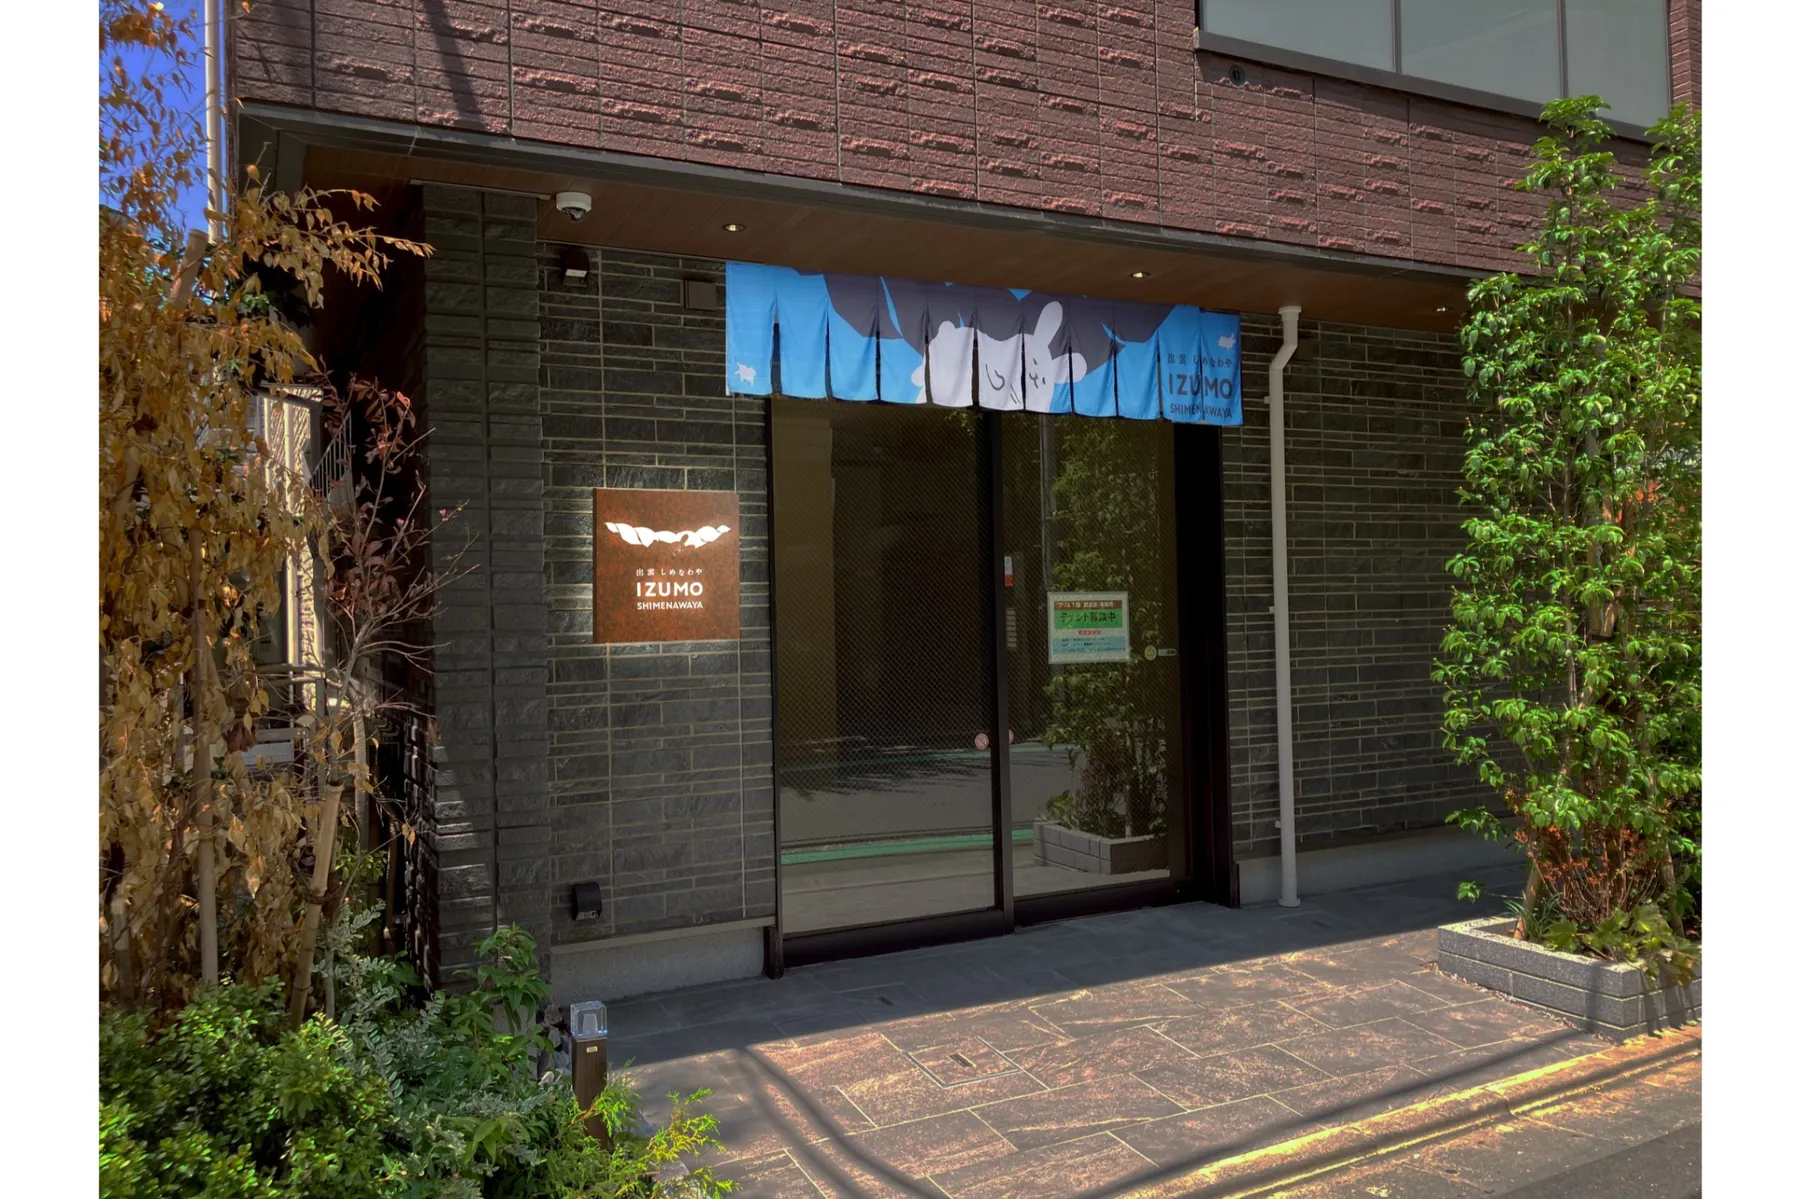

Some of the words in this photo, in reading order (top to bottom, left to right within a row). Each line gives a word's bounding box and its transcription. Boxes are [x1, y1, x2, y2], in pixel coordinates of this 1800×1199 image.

[1169, 373, 1233, 400] IZUMO
[1170, 402, 1232, 418] SHIMENAWAYA
[660, 568, 703, 577] しめなわや
[636, 582, 704, 597] IZUMO
[637, 601, 704, 610] SHIMENAWAYA
